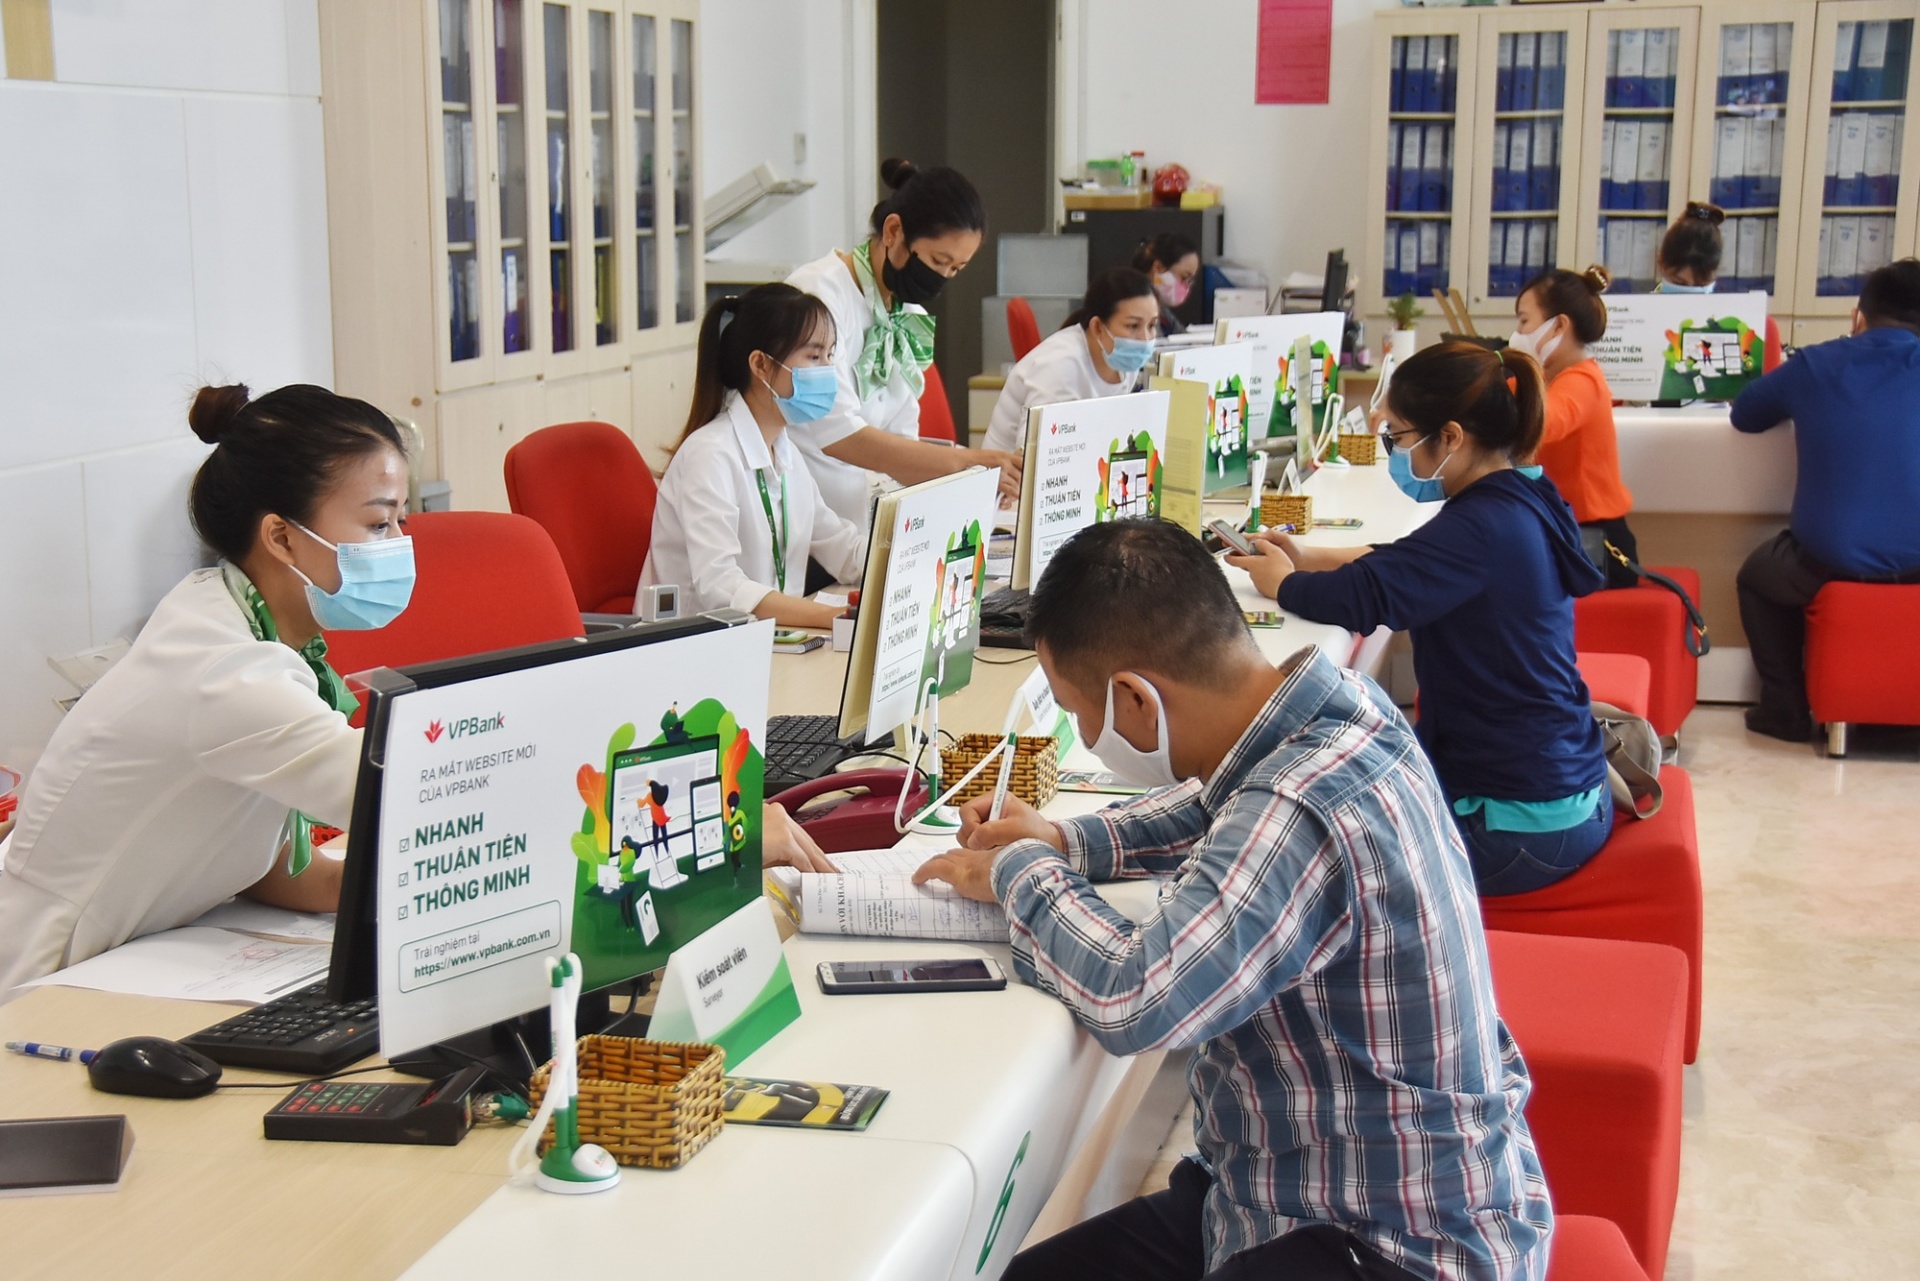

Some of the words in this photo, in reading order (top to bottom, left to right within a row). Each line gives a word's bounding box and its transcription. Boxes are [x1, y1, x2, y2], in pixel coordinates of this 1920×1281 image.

[1046, 474, 1068, 489] NHANH
[1044, 509, 1065, 524] THÔNG
[1065, 506, 1081, 520] MINH
[893, 584, 912, 604] NHANH
[904, 623, 918, 640] MINH
[448, 711, 505, 740] VPBank
[420, 768, 436, 783] RA
[438, 760, 463, 779] MẮT
[465, 749, 514, 772] WEBSITE
[516, 742, 536, 760] MỚI
[419, 785, 443, 803] CỦA
[445, 774, 490, 797] VPBANK
[415, 812, 484, 848] NHANH
[414, 845, 480, 881] THUẬN
[485, 833, 526, 862] TIỆN
[414, 879, 479, 914] THÔNG
[483, 864, 530, 896] MINH
[414, 945, 433, 960] Trải
[434, 936, 467, 957] nghiệm
[468, 930, 480, 946] tại
[414, 929, 550, 978] https://www.vpbank.com.vn
[696, 968, 717, 989] Kiểm
[716, 955, 733, 976] soát
[731, 947, 748, 965] viên
